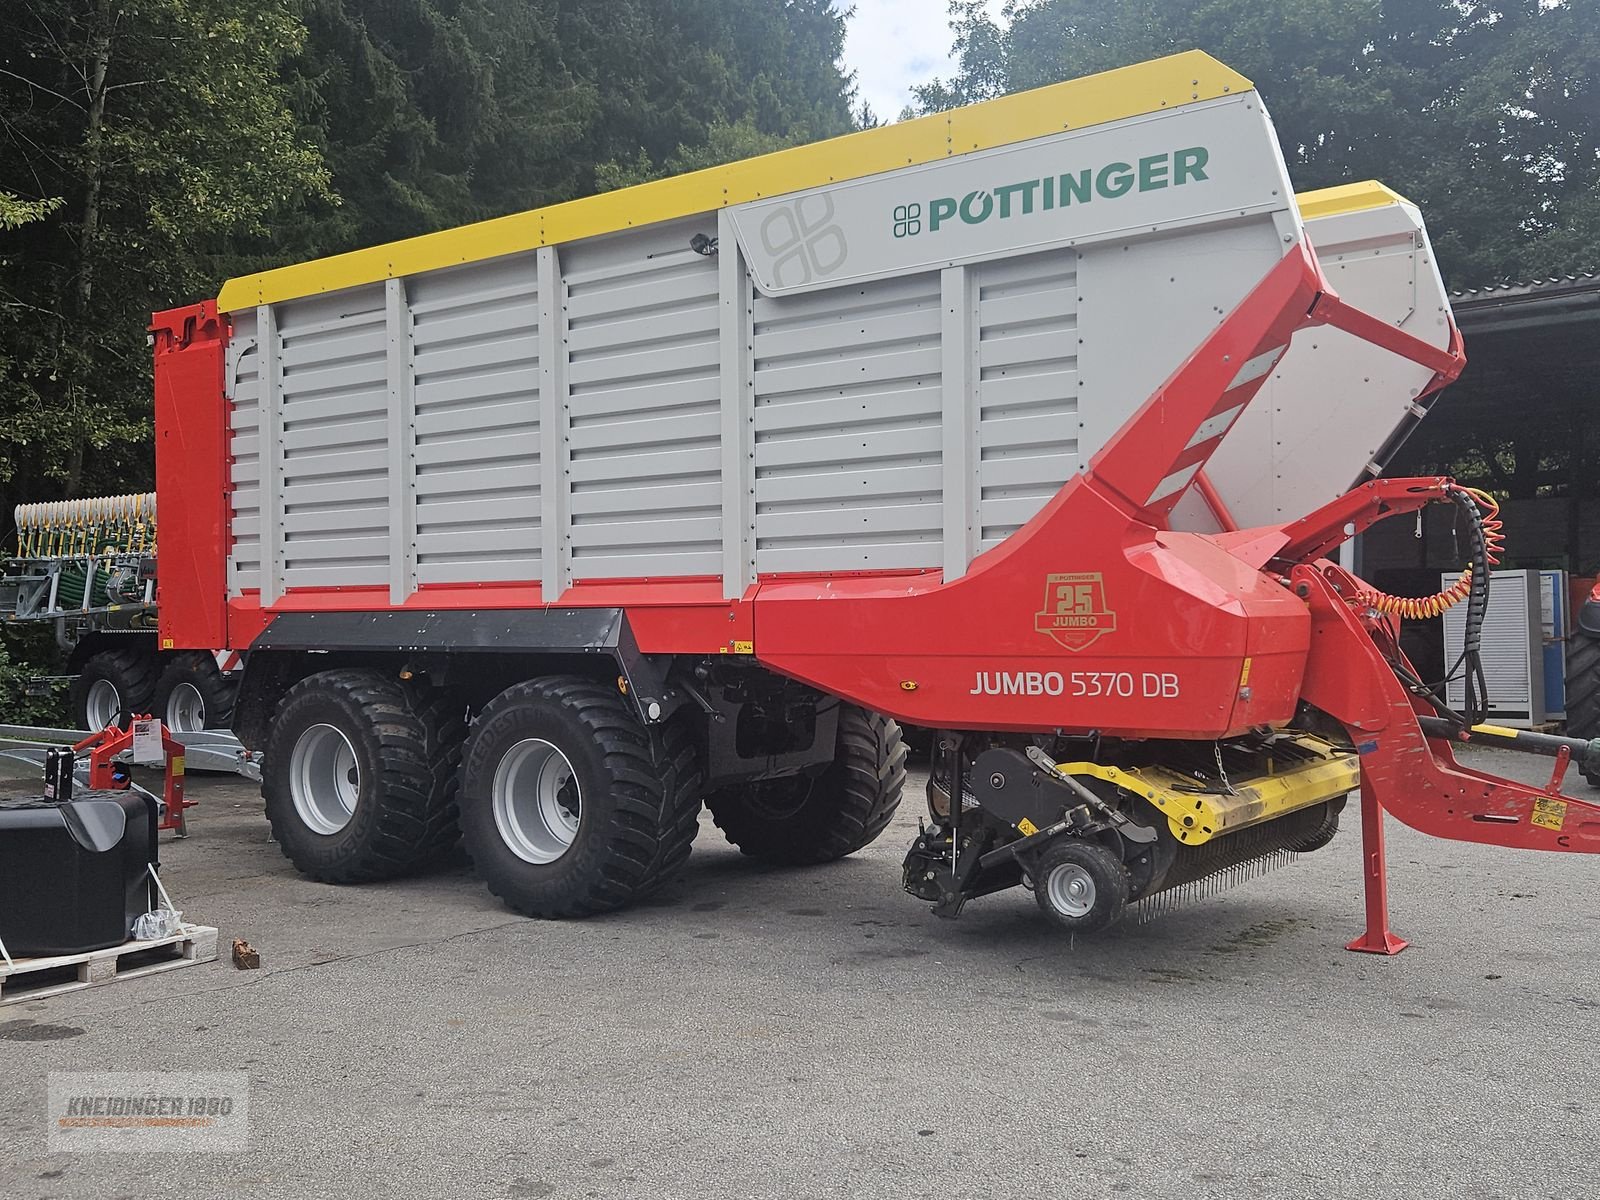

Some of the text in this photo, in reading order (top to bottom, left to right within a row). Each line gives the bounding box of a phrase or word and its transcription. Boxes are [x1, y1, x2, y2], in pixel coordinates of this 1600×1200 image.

[929, 146, 1209, 232] PÖTTINGER
[1057, 585, 1092, 614] 25
[1053, 616, 1097, 627] JUMBO
[970, 672, 1180, 698] JUMBO 5370 DB
